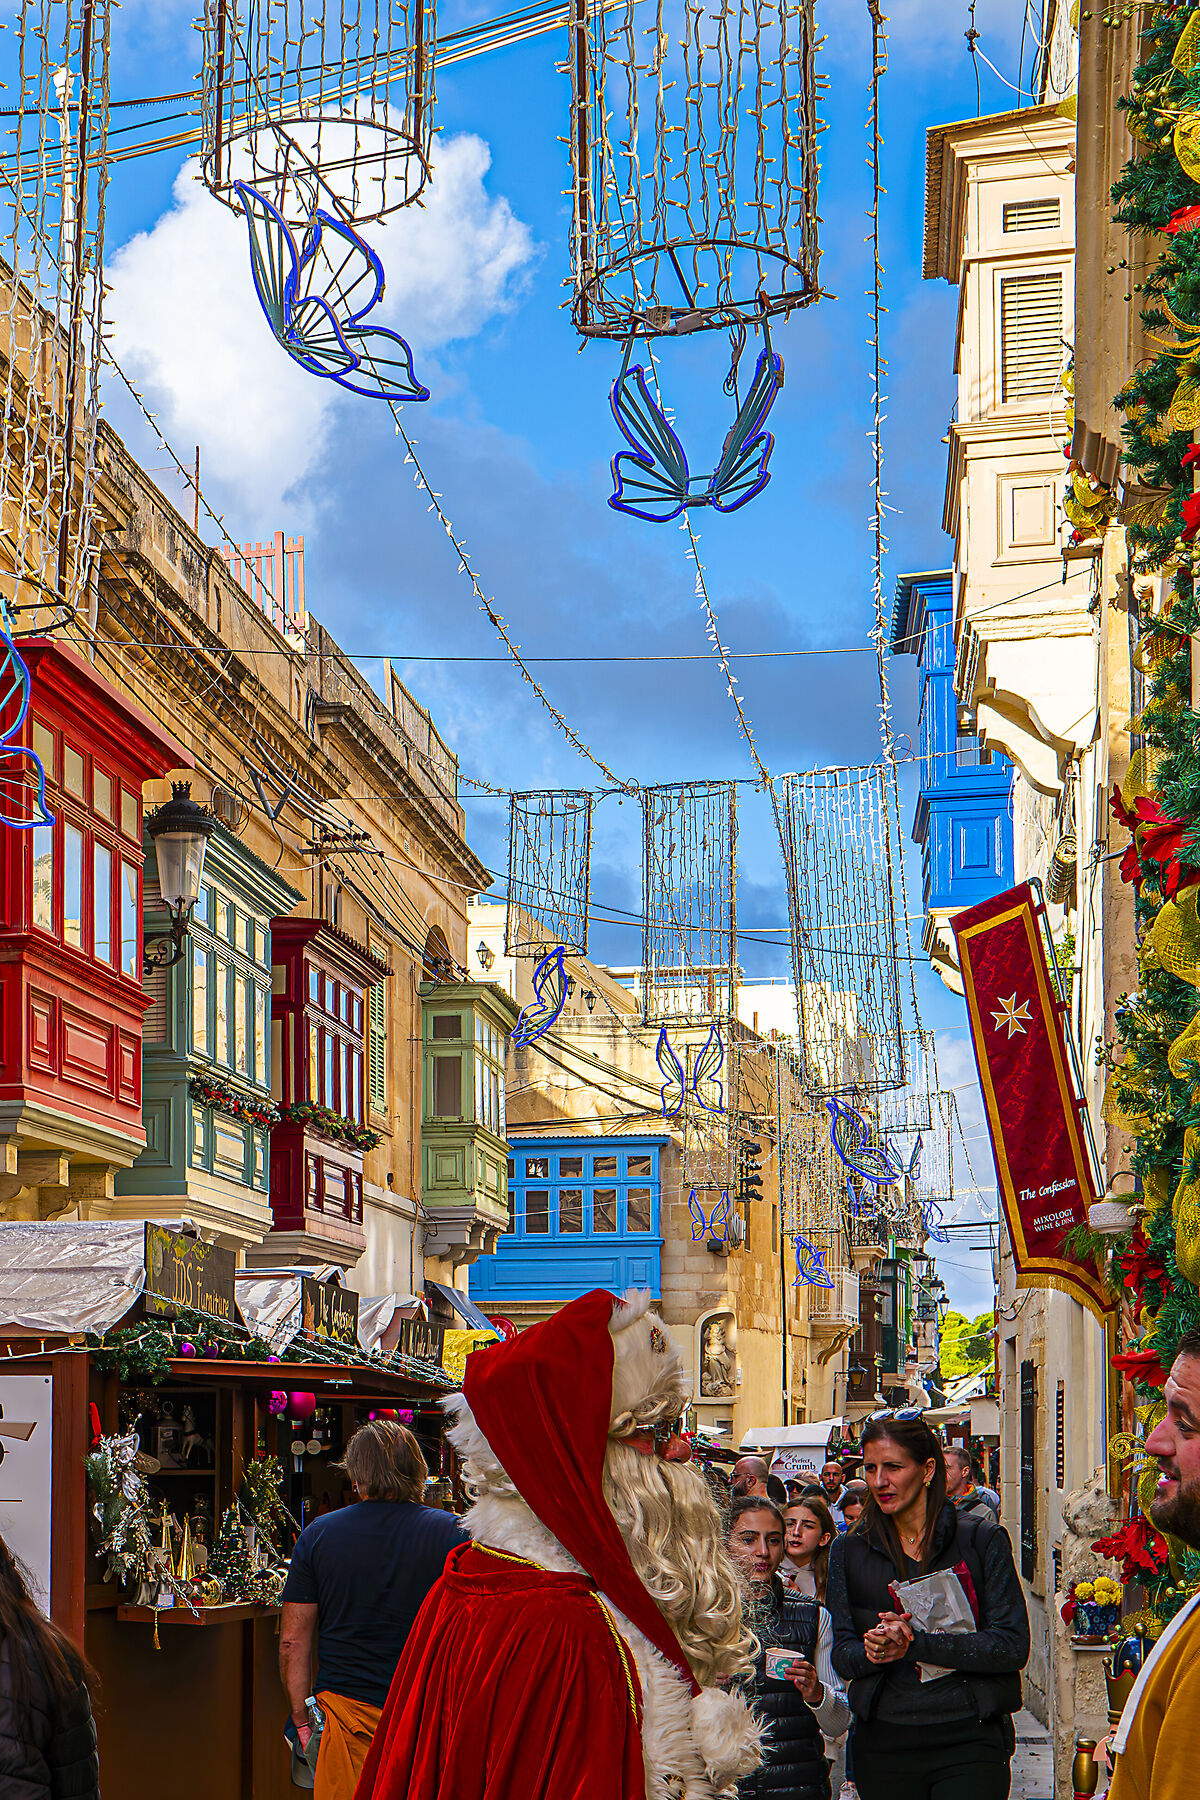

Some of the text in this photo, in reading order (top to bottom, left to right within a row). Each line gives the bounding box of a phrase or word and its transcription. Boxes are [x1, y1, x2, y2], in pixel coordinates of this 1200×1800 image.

[1019, 1178, 1077, 1201] The Confession
[1033, 1208, 1073, 1226] MIXOLOGY
[1034, 1222, 1054, 1233] WINE
[1054, 1219, 1061, 1228] &
[172, 1256, 230, 1318] JDS Furniture
[318, 1284, 329, 1323] The
[784, 1461, 817, 1471] Crumb
